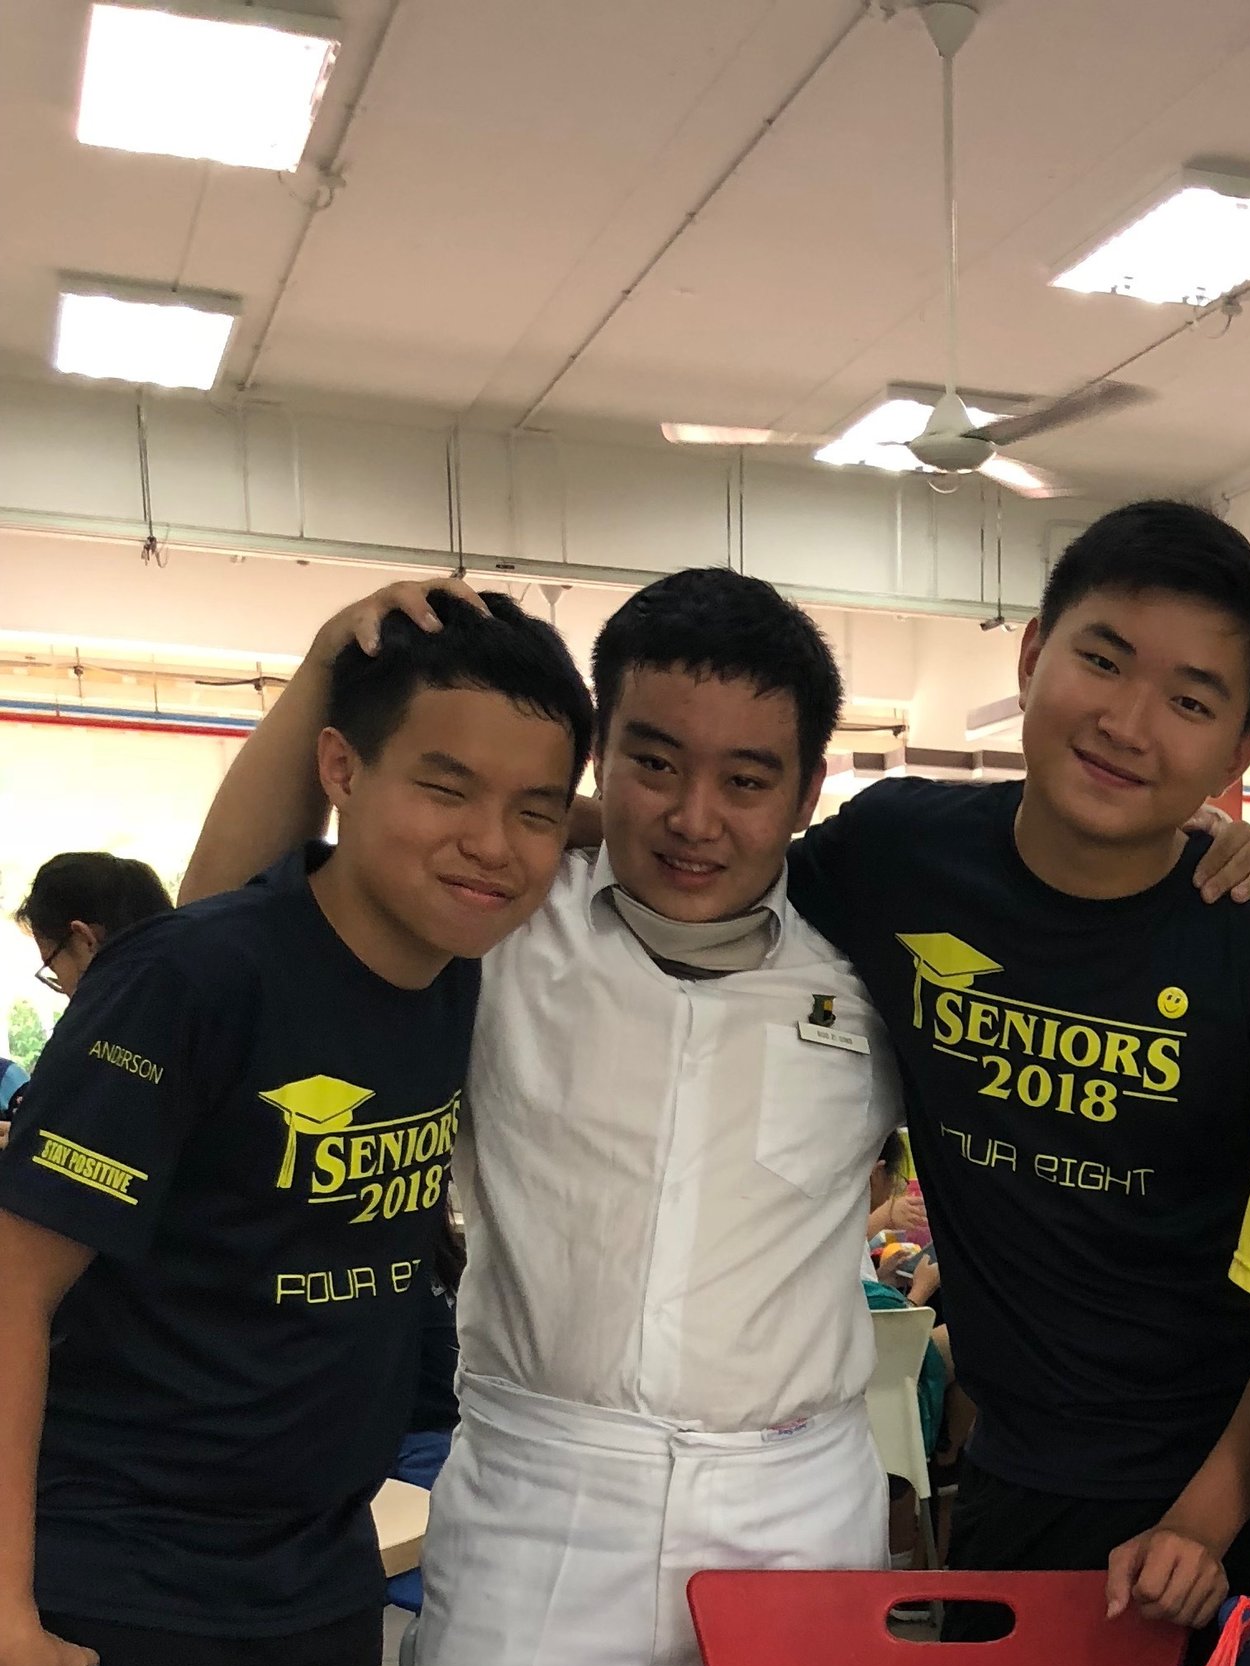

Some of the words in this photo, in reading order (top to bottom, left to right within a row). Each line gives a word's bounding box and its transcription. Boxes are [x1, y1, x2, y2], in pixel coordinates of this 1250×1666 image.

[89, 1040, 164, 1085] ANDERSON
[934, 991, 1181, 1092] SENIORS
[978, 1055, 1118, 1123] 2018
[41, 1139, 72, 1166] STAY
[68, 1150, 133, 1193] POSITIVE
[348, 1164, 443, 1224] 2018
[276, 1266, 377, 1304] FOUR
